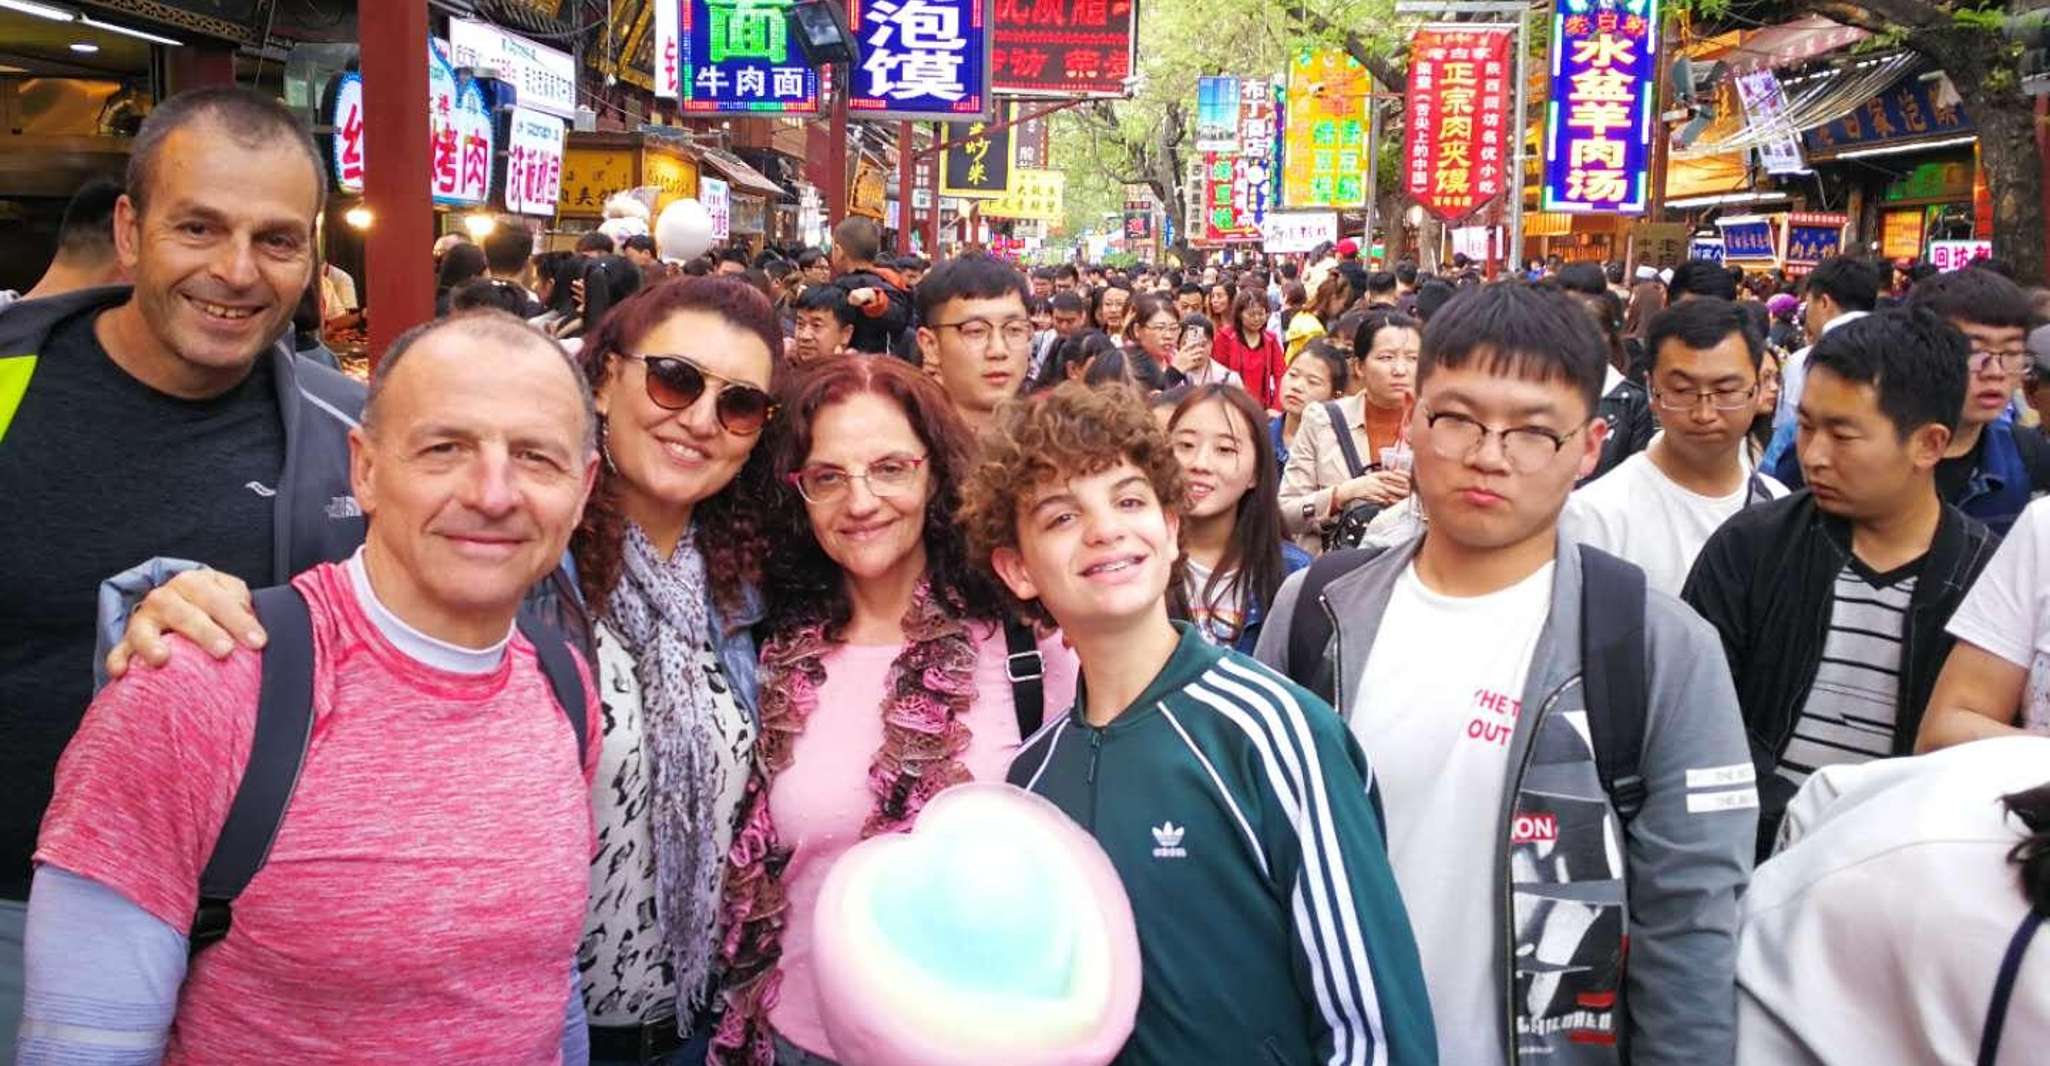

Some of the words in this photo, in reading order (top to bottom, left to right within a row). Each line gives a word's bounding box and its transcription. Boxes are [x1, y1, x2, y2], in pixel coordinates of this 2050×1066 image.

[696, 64, 805, 98] 牛肉面
[862, 0, 967, 100] 泡馍
[1434, 61, 1478, 194] 正宗肉夹馍
[1566, 33, 1637, 202] 水盆羊肉汤
[1468, 718, 1511, 746] OUT
